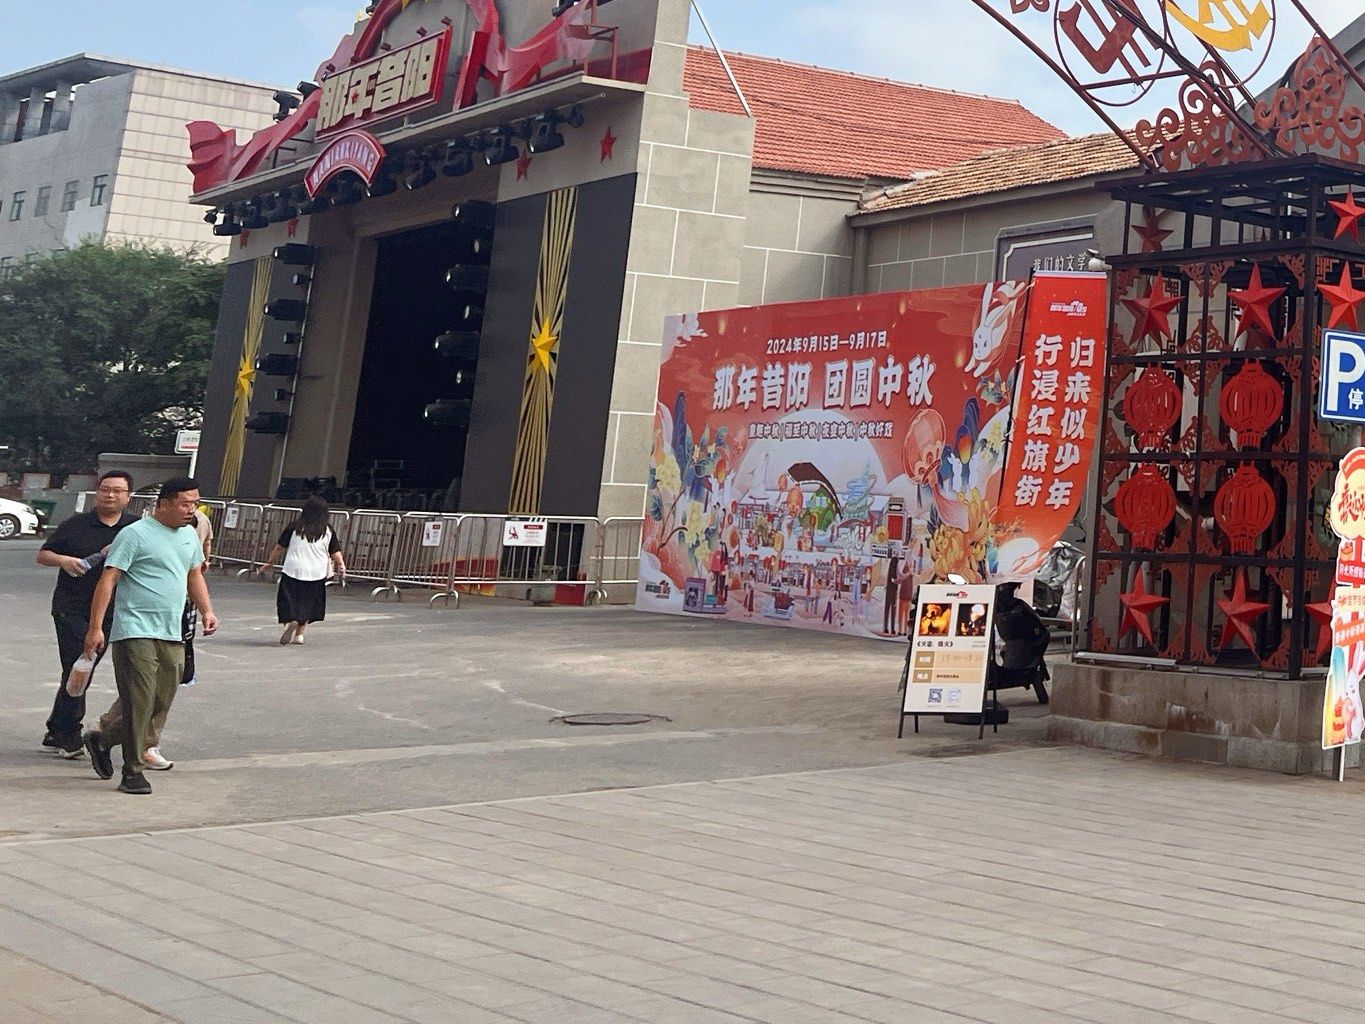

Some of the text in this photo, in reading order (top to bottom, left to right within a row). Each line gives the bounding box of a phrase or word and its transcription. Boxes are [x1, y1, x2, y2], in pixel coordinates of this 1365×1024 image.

[316, 39, 438, 132] 那年昔阳
[712, 353, 936, 411] 那年昔阳 团圆中秋
[1014, 333, 1063, 509] 行浸红旗街
[1044, 336, 1094, 512] 归来似少年
